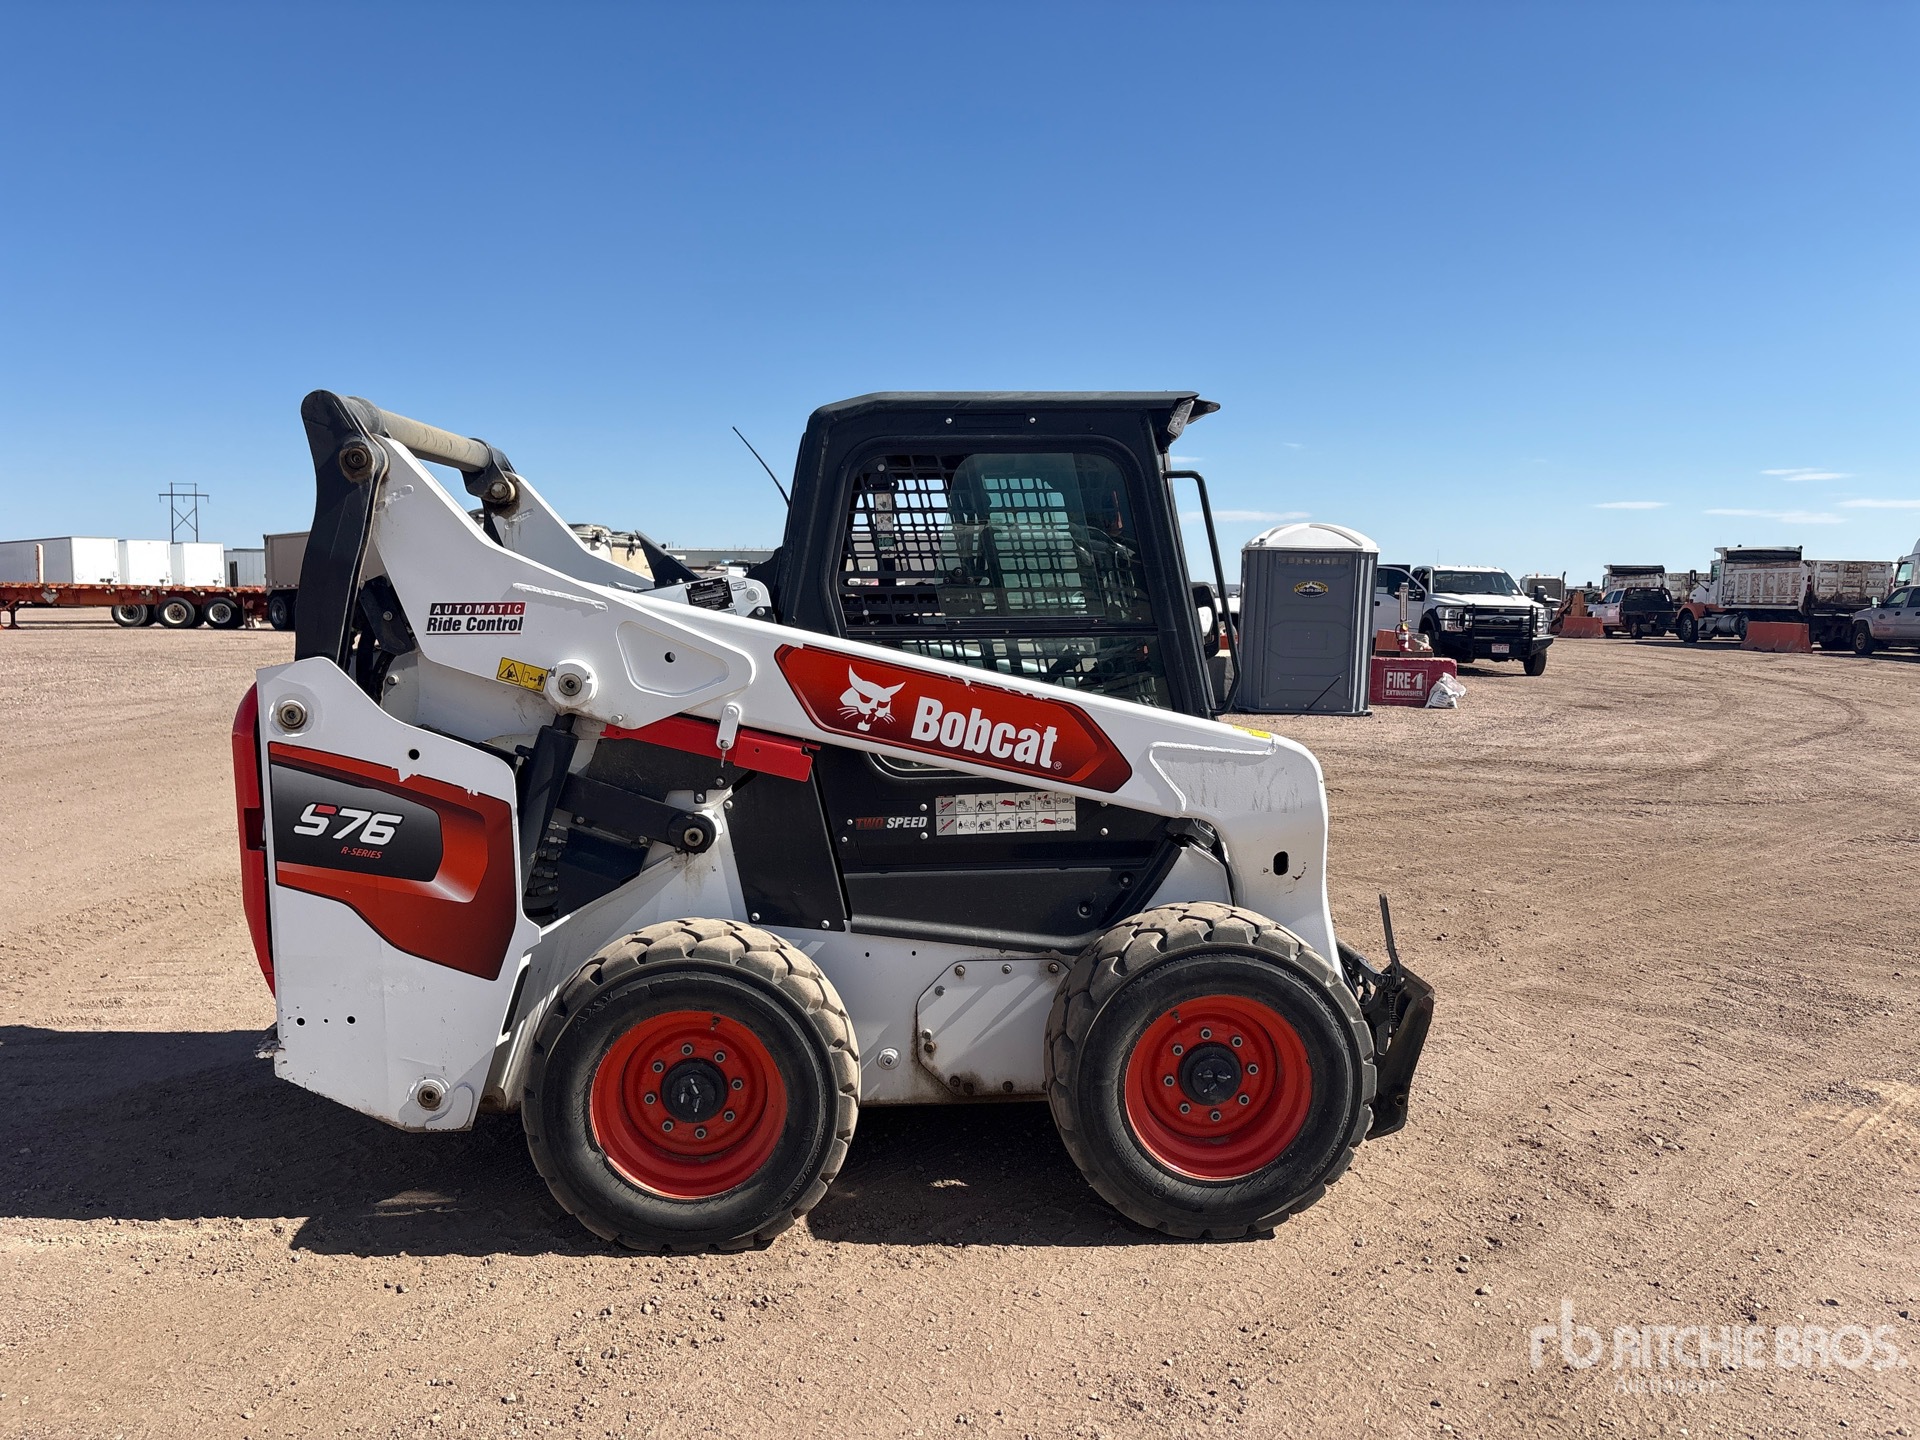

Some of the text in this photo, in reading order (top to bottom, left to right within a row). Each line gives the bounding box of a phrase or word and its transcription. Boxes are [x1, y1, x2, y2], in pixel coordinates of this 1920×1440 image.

[433, 604, 522, 615] AUTOMATIC
[426, 616, 524, 632] Ride Control
[1386, 672, 1411, 689] FIRE
[1385, 689, 1423, 697] EXTINGUISHER
[293, 803, 403, 846] S76
[856, 816, 928, 830] TWO SPEED
[340, 846, 383, 859] R-SERIES
